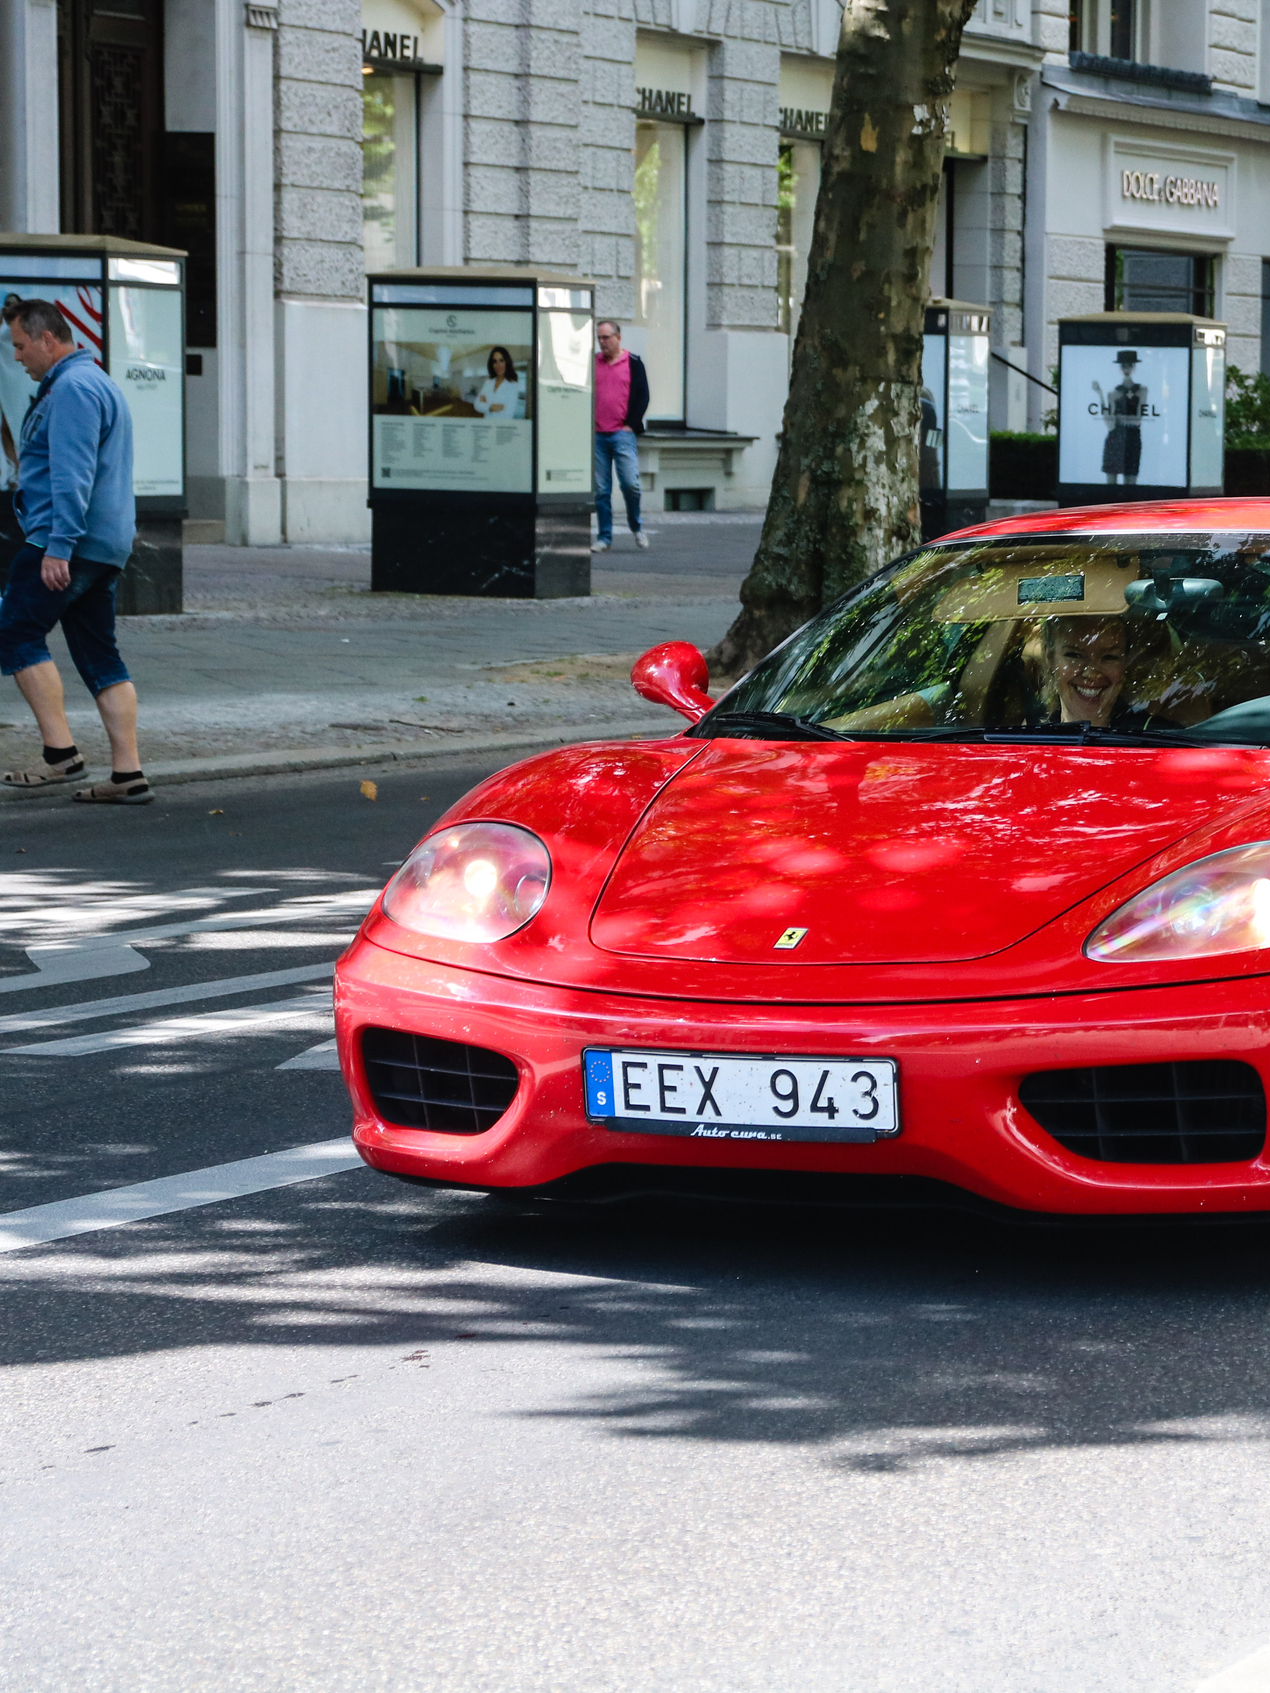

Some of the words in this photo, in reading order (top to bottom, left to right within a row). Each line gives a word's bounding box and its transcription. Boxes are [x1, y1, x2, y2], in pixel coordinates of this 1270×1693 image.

[1122, 170, 1160, 201] DOLCE
[1165, 176, 1219, 207] GABBANA
[126, 368, 166, 381] AGNONA
[597, 1092, 607, 1105] S
[621, 1061, 723, 1117] EEX
[769, 1069, 880, 1120] 943
